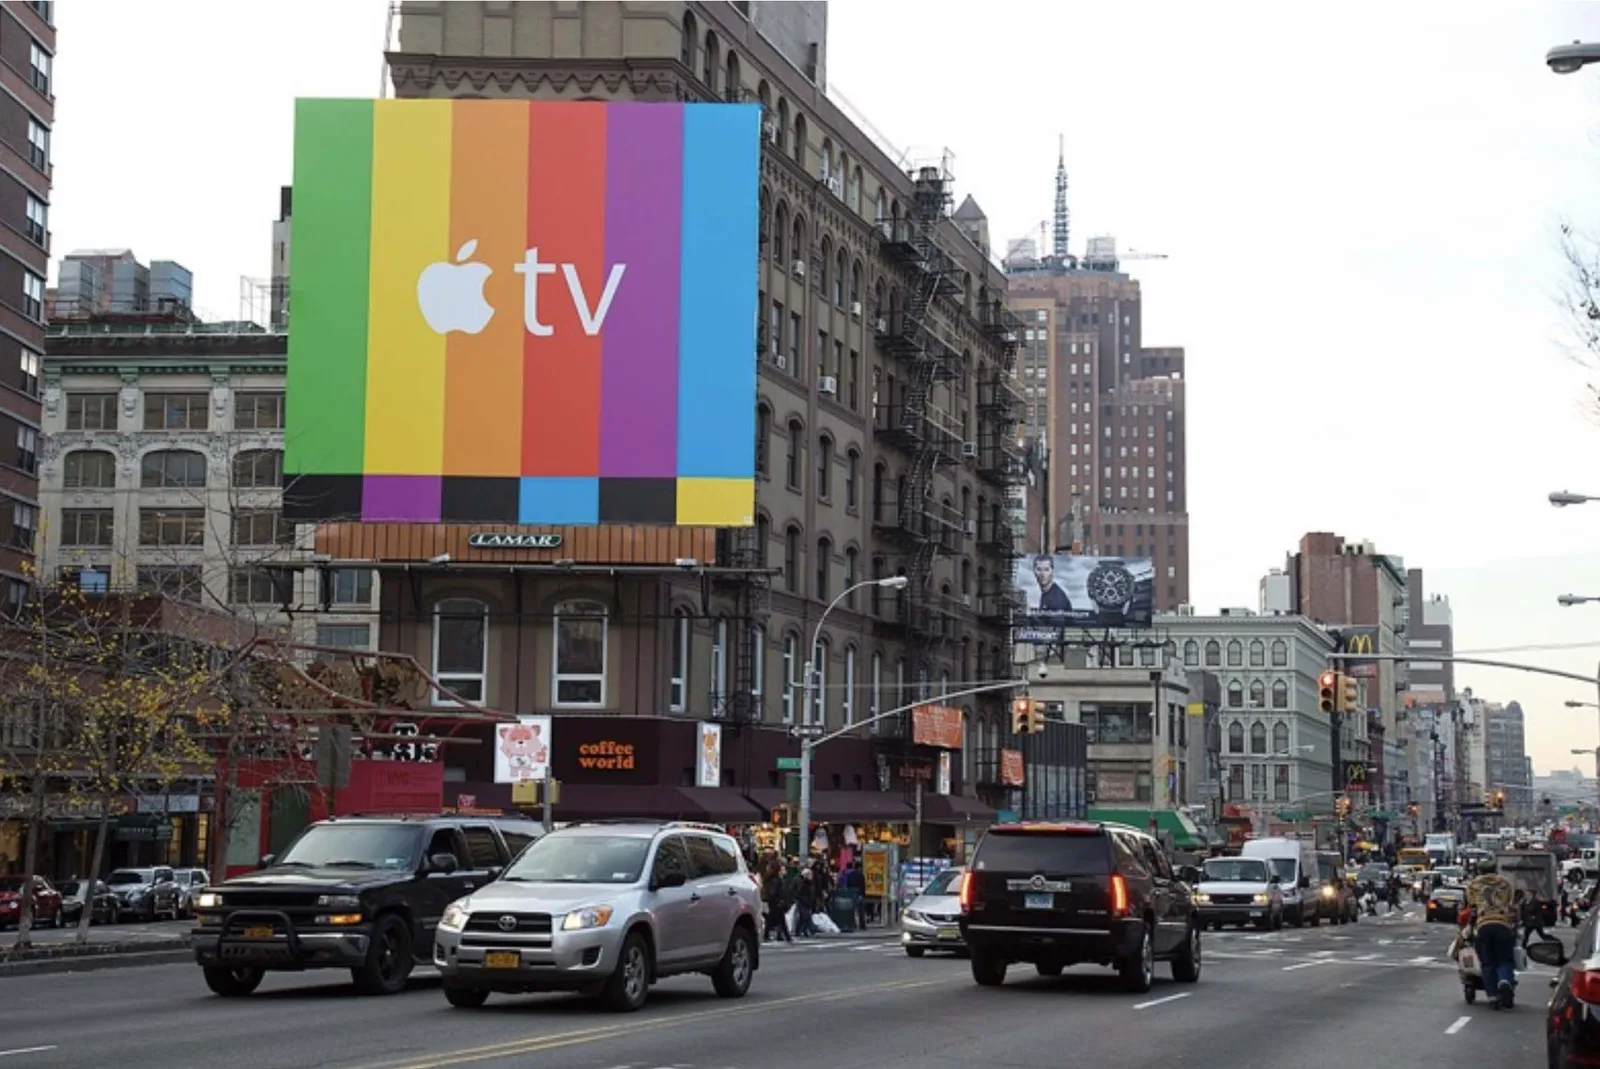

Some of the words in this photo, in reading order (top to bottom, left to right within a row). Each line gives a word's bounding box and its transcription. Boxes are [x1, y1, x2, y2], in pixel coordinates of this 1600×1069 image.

[514, 247, 626, 336] tv
[475, 533, 554, 544] LAMAR
[579, 740, 635, 755] coffee
[578, 755, 635, 769] world
